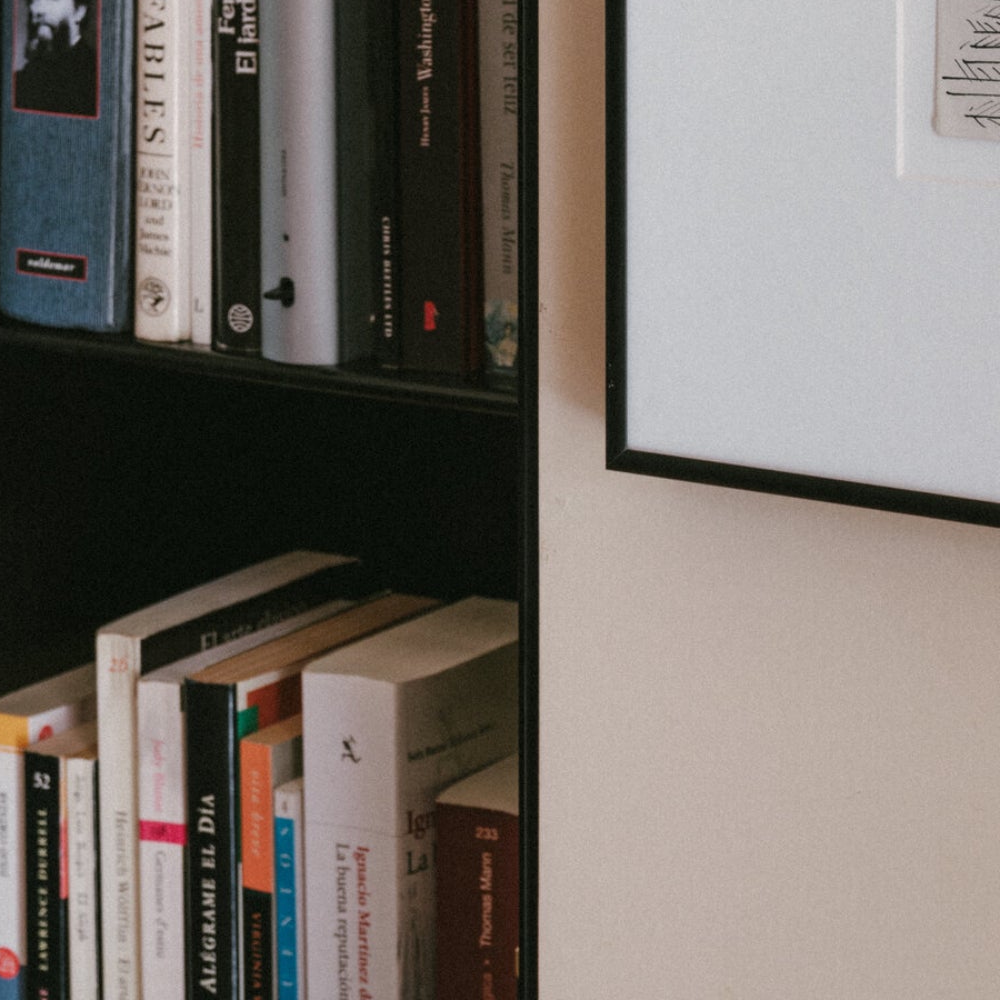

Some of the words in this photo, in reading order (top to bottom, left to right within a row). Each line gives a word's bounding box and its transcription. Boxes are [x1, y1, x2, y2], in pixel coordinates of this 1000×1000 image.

[502, 12, 518, 36] de
[236, 50, 258, 75] El
[503, 42, 517, 69] ser
[32, 771, 52, 790] 52
[196, 793, 216, 835] DÍA
[36, 808, 48, 881] DURRELL
[200, 844, 216, 869] EL
[335, 843, 351, 861] La
[336, 866, 351, 914] buena
[352, 846, 372, 907] Ignacio
[478, 851, 493, 891] Mann
[36, 886, 49, 972] LAWRENCE
[199, 877, 218, 994] ALÉGRAME
[478, 894, 493, 947] Thomas
[357, 911, 372, 985] Martínez
